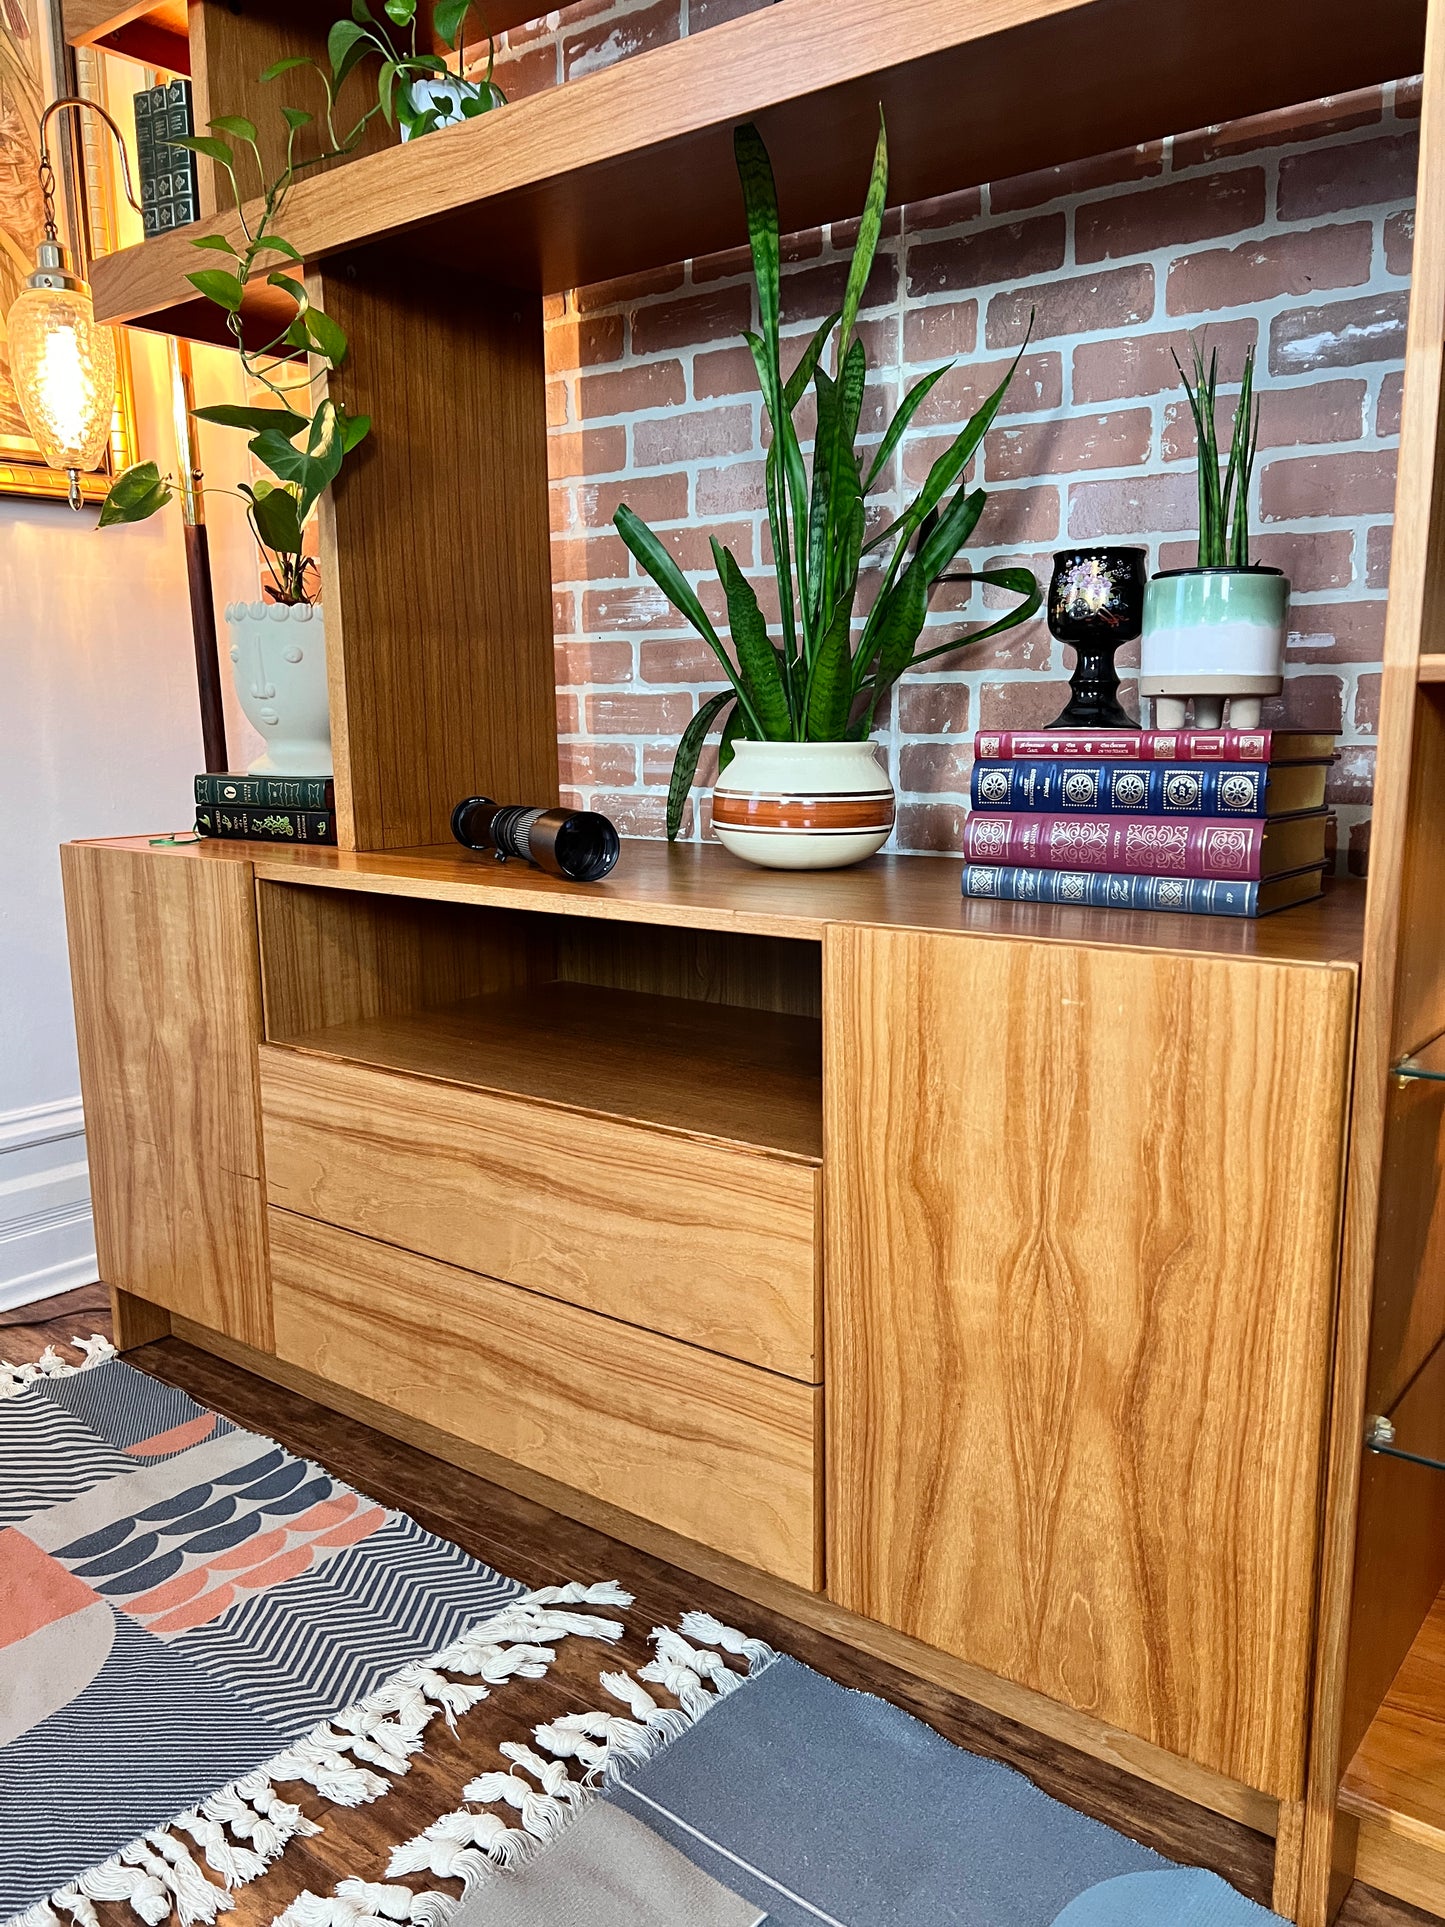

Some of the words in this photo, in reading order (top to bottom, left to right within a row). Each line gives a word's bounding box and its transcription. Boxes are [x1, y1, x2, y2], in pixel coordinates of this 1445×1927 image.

[1022, 830, 1030, 851] ANNA
[1029, 823, 1039, 858] KARENINA
[1113, 830, 1121, 859] TOLSTOY
